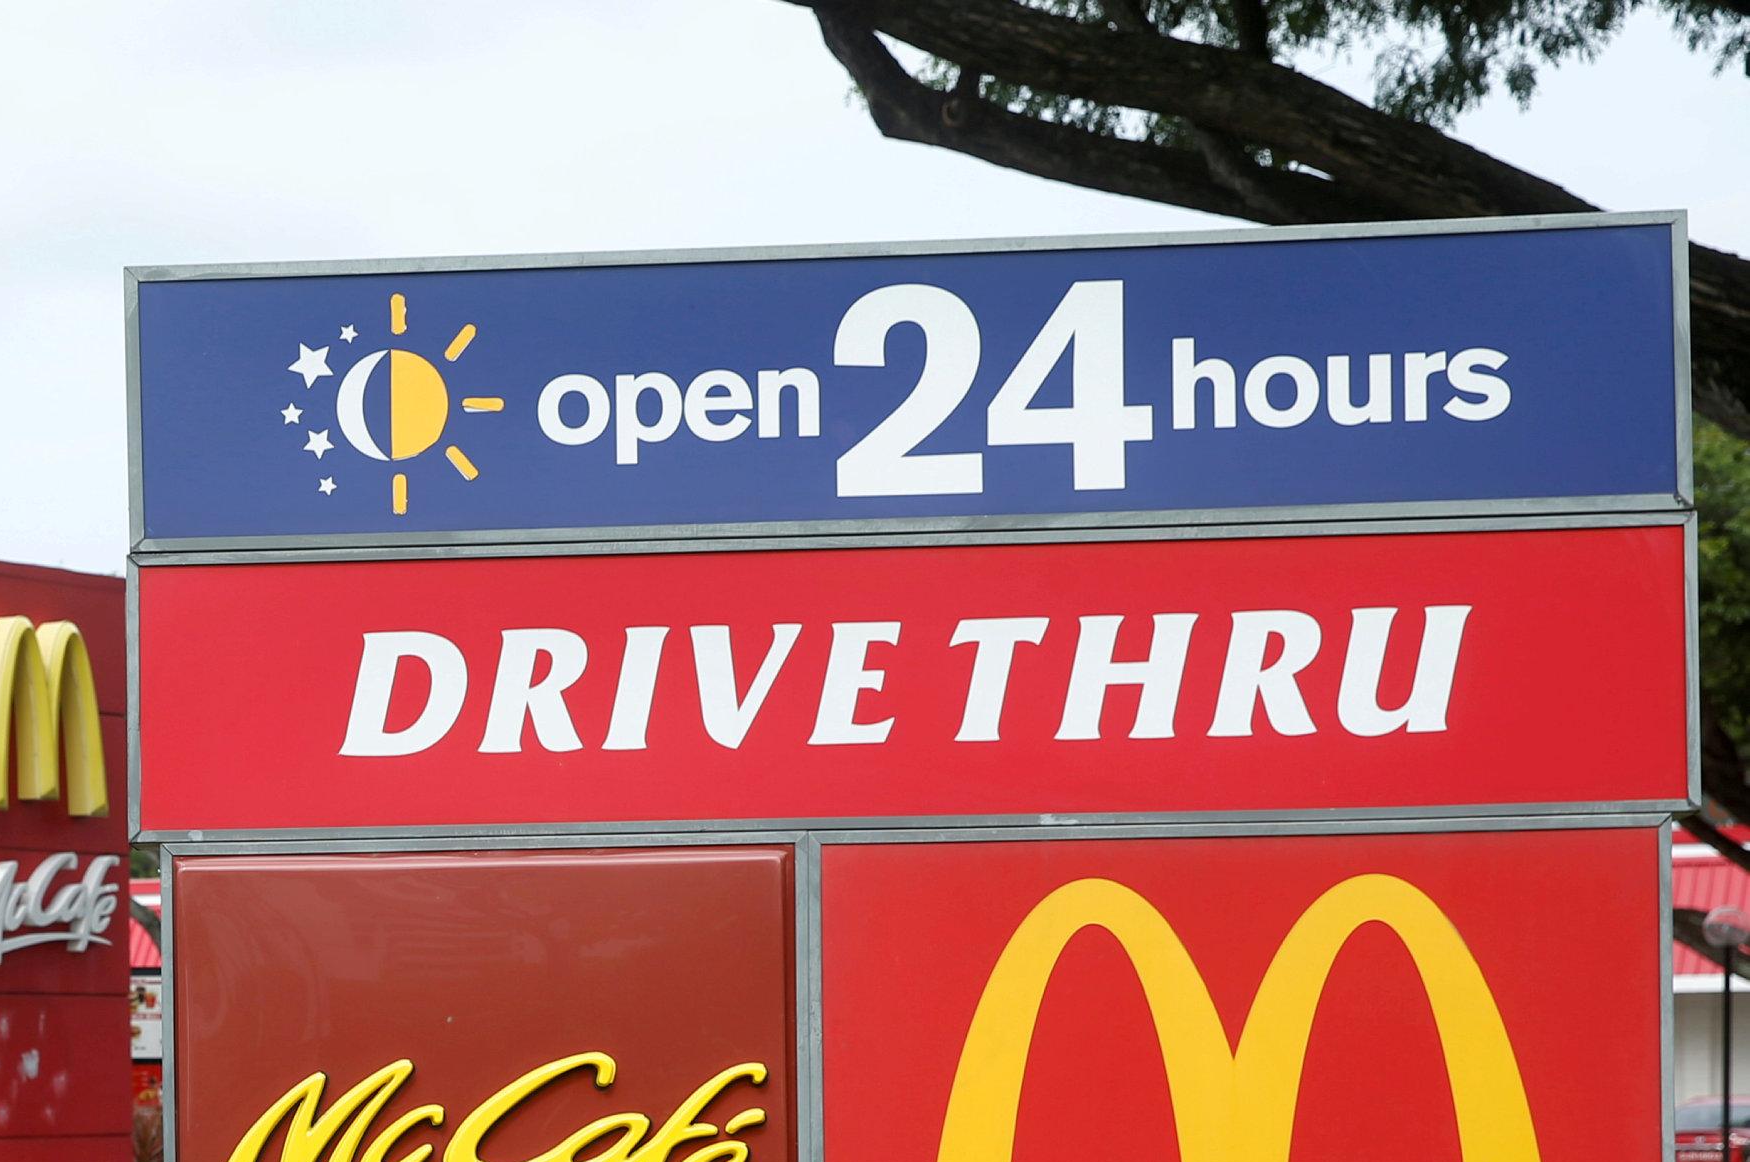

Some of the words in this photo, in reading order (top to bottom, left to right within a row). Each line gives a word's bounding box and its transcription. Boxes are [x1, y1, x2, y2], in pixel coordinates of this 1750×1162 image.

[537, 367, 820, 465] open
[833, 279, 1153, 498] 24
[1172, 337, 1512, 430] hours
[337, 620, 903, 757] DRIVE
[948, 604, 1473, 742] THRU
